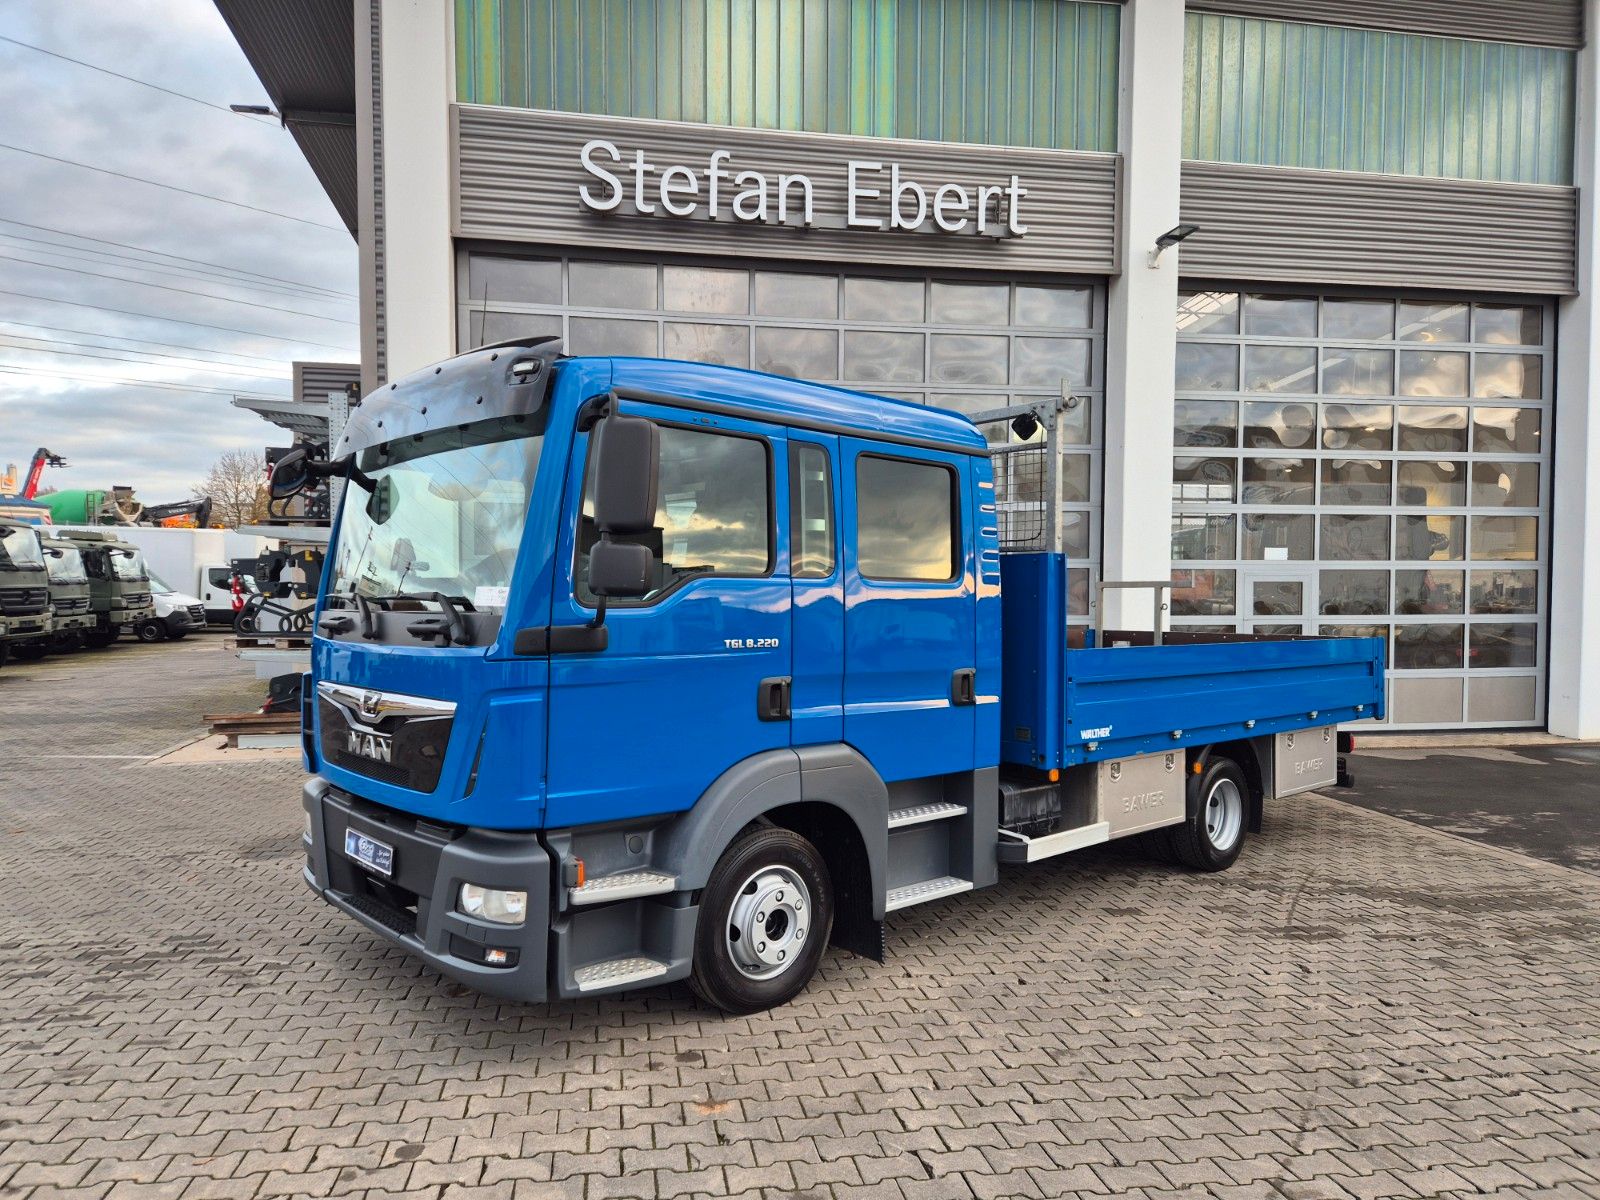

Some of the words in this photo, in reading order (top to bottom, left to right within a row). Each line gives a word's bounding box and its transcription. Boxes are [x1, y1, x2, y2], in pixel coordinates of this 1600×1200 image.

[579, 139, 814, 225] Stefan
[847, 160, 1028, 238] Ebert
[724, 639, 745, 649] TGL
[746, 638, 779, 648] 8.220
[1080, 726, 1111, 740] WALTHER
[348, 731, 393, 763] MAN
